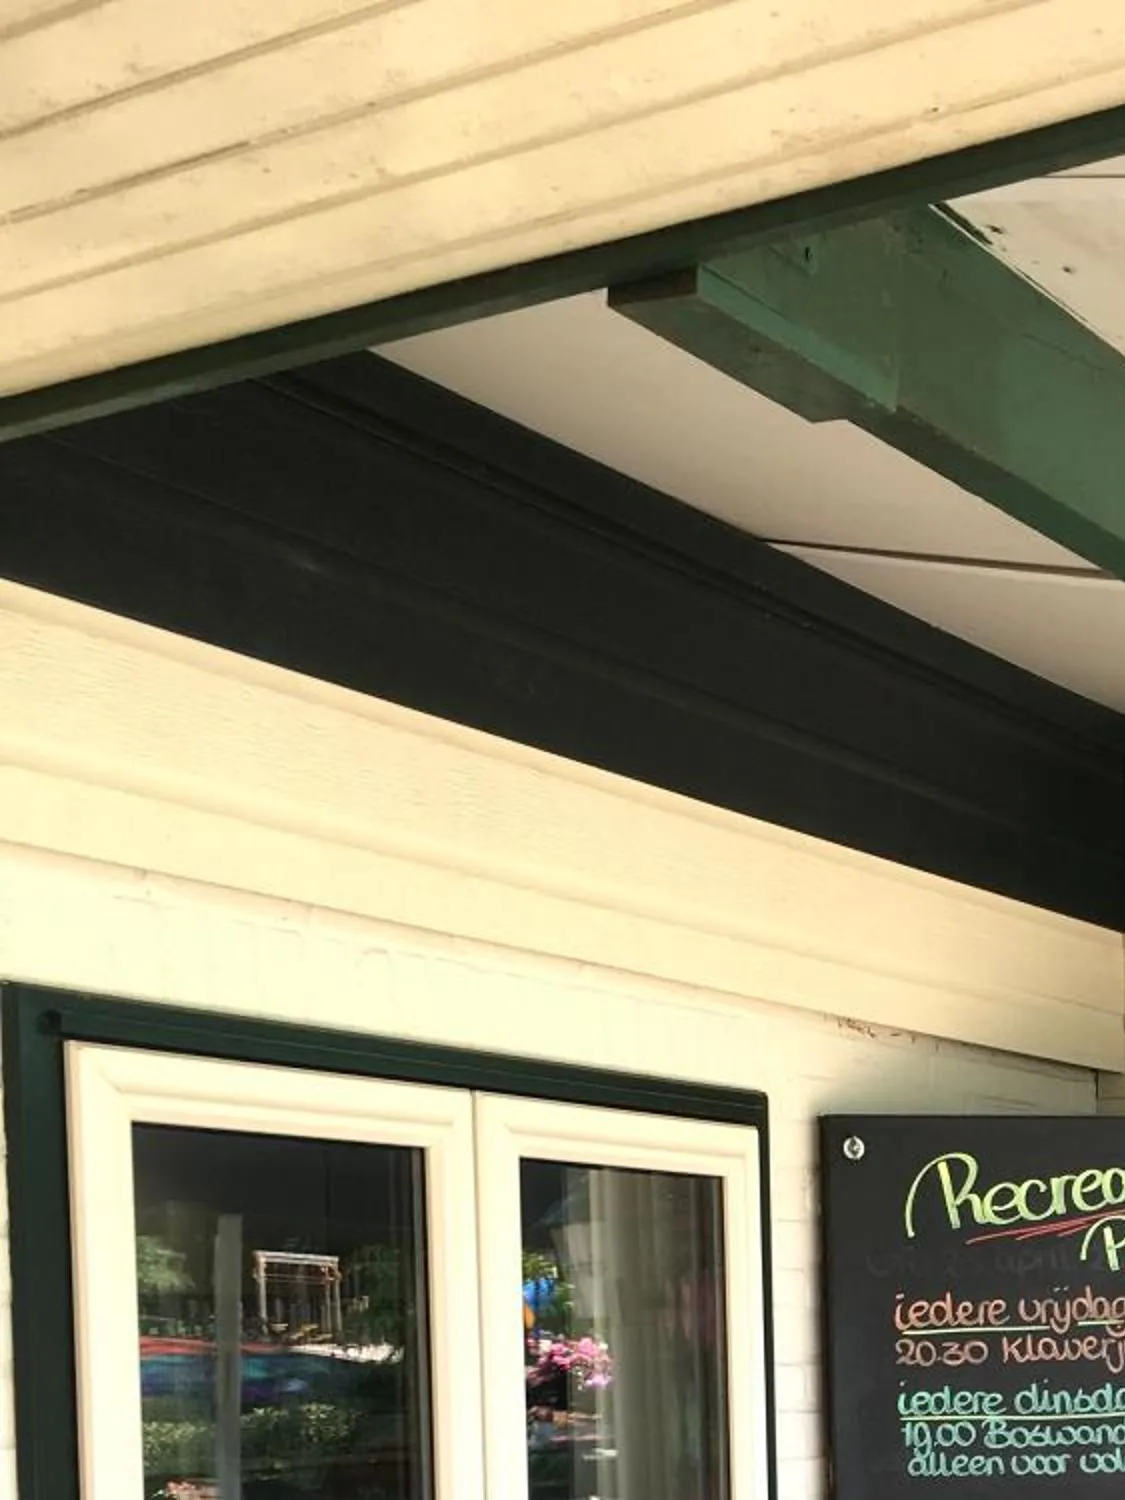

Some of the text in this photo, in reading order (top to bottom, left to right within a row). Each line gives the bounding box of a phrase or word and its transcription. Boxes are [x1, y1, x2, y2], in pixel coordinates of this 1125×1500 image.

[894, 1294, 1009, 1330] iedere
[895, 1340, 988, 1367] 20.30
[897, 1379, 1003, 1415] iedere
[908, 1448, 1005, 1476] alleen
[1011, 1452, 1071, 1474] voor
